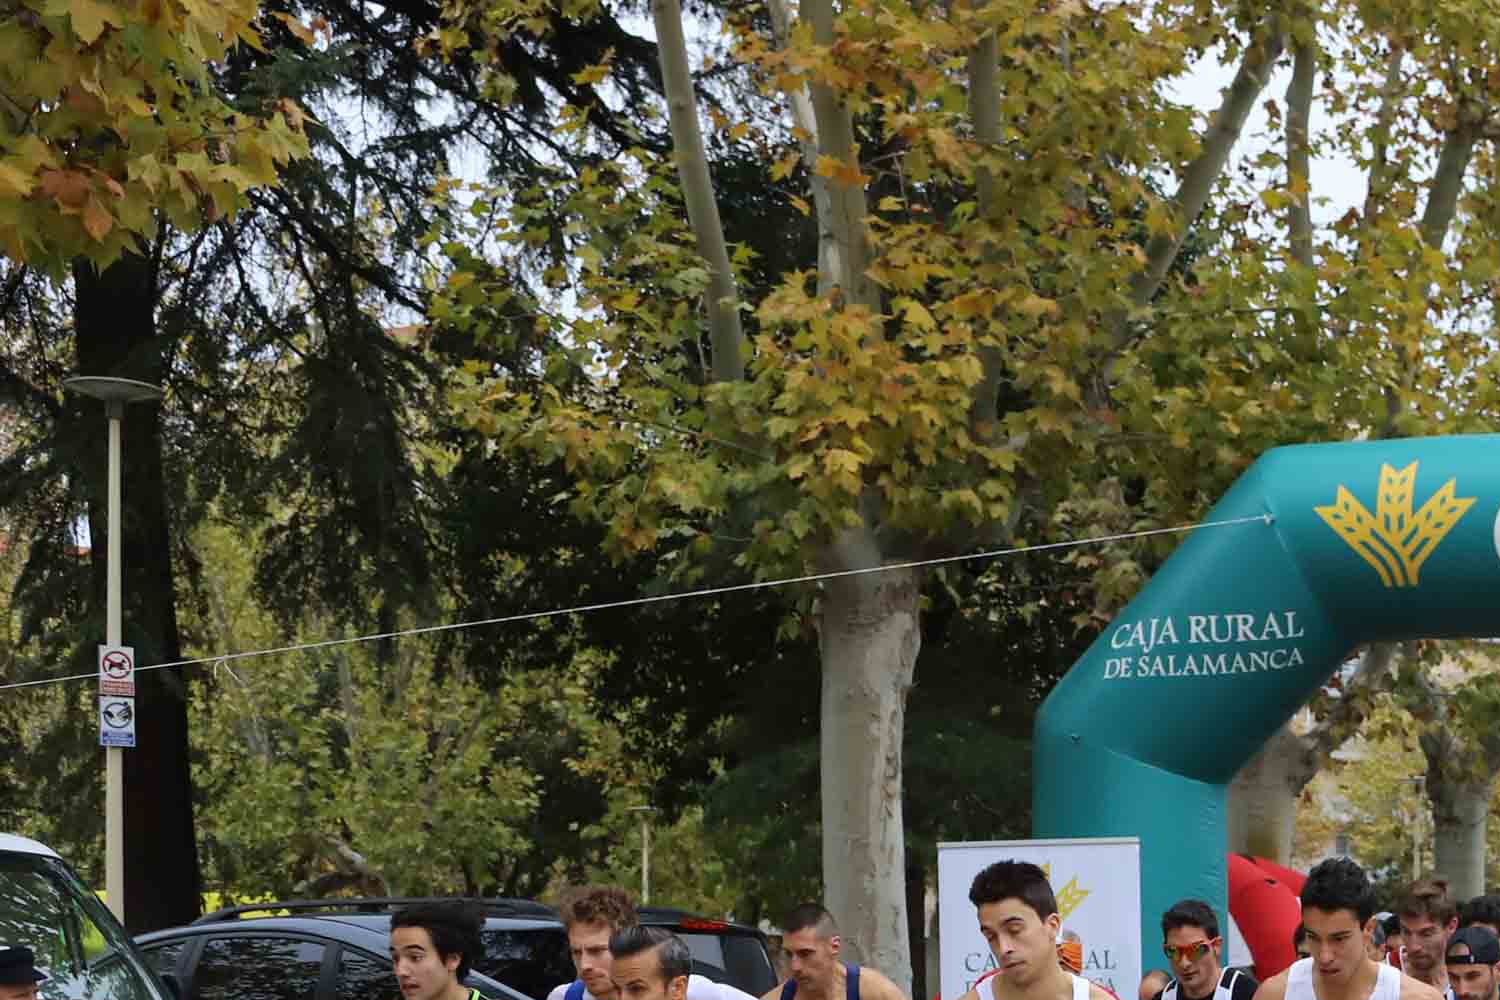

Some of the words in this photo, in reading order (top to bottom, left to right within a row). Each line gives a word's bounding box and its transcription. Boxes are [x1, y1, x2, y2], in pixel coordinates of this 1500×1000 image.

[1111, 616, 1179, 653] CAJA
[1188, 611, 1304, 643] RURAL
[1104, 657, 1132, 679] DE
[1137, 647, 1304, 678] SALAMANCA
